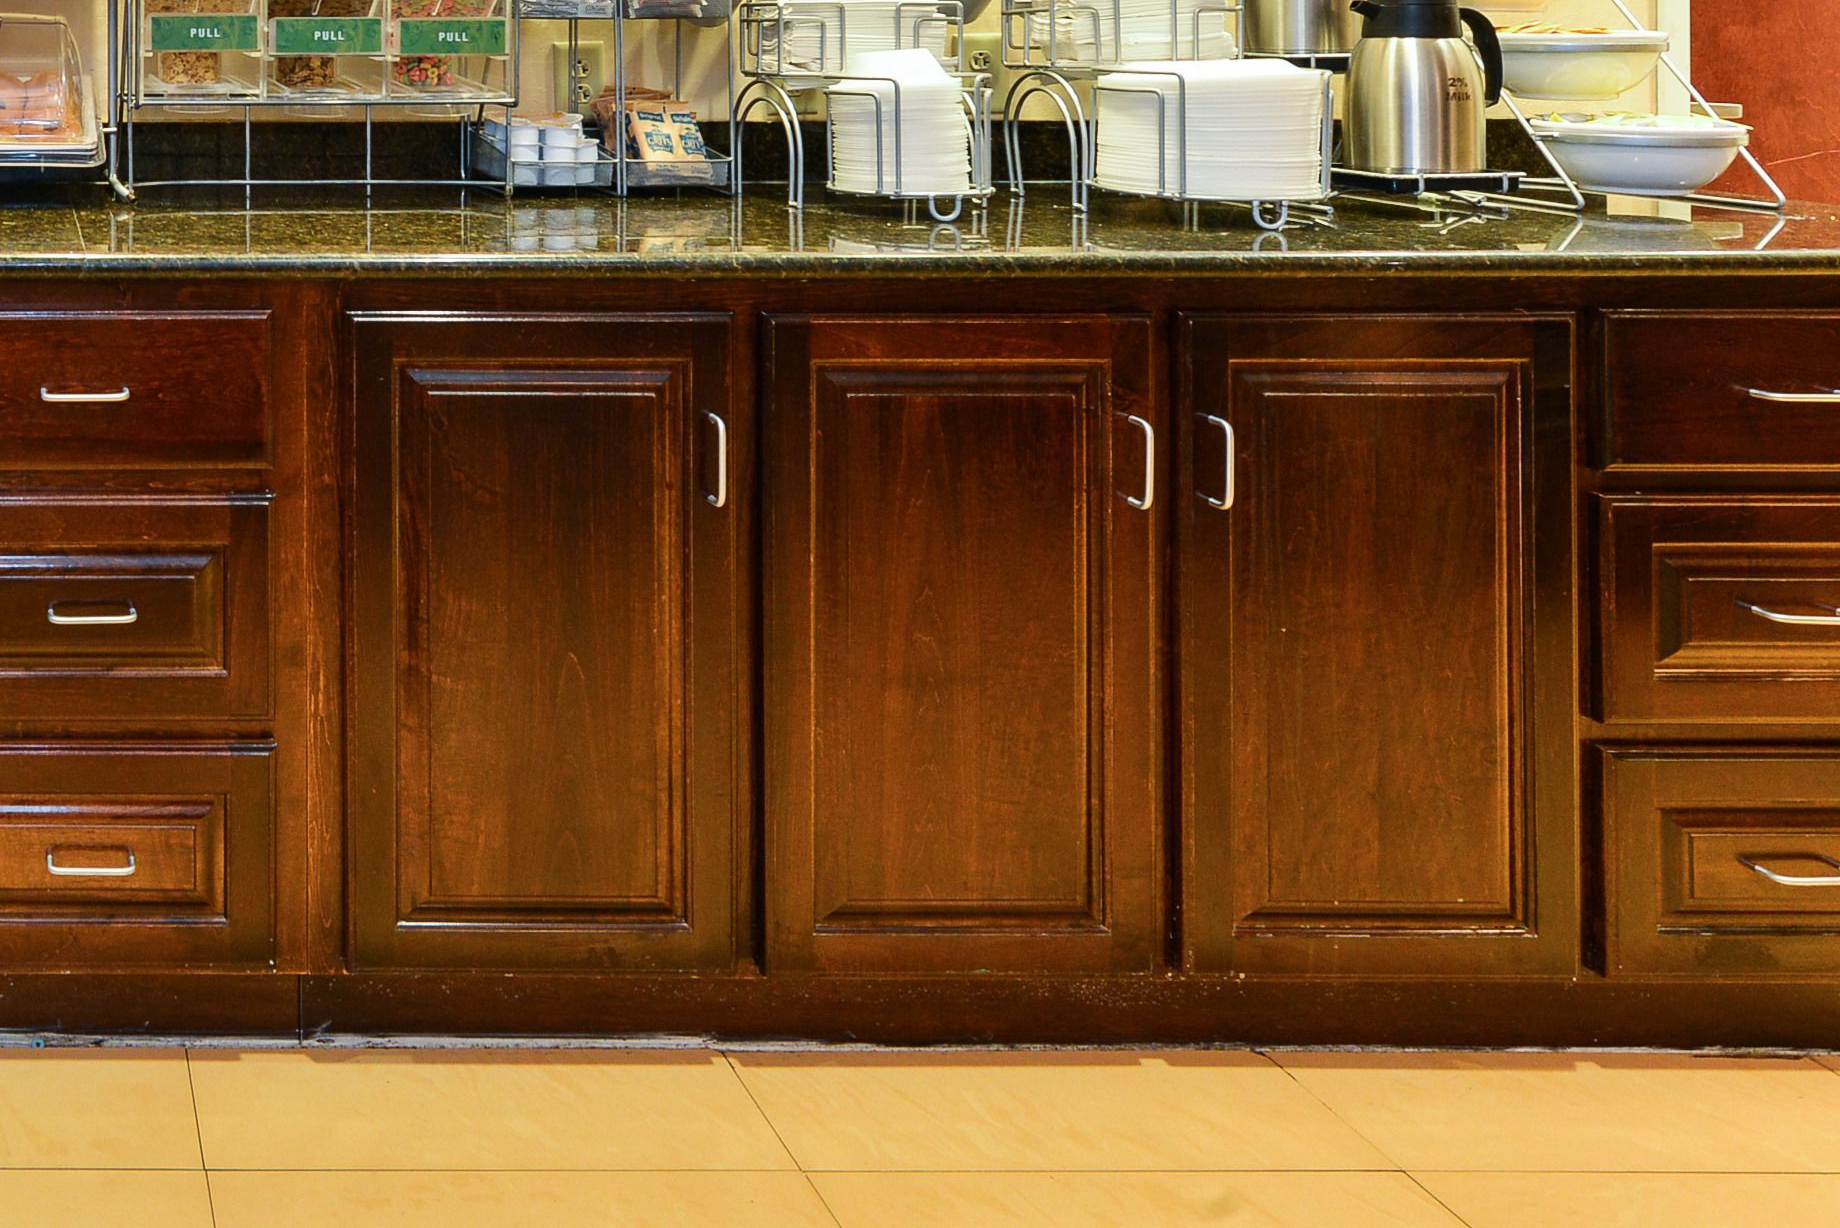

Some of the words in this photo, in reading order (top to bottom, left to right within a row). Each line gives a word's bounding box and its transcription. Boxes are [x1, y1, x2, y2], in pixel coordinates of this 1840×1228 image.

[190, 28, 221, 39] PULL
[314, 30, 345, 42] PULL
[438, 31, 469, 43] PULL
[1447, 76, 1469, 88] 2%
[1446, 91, 1472, 102] Milk
